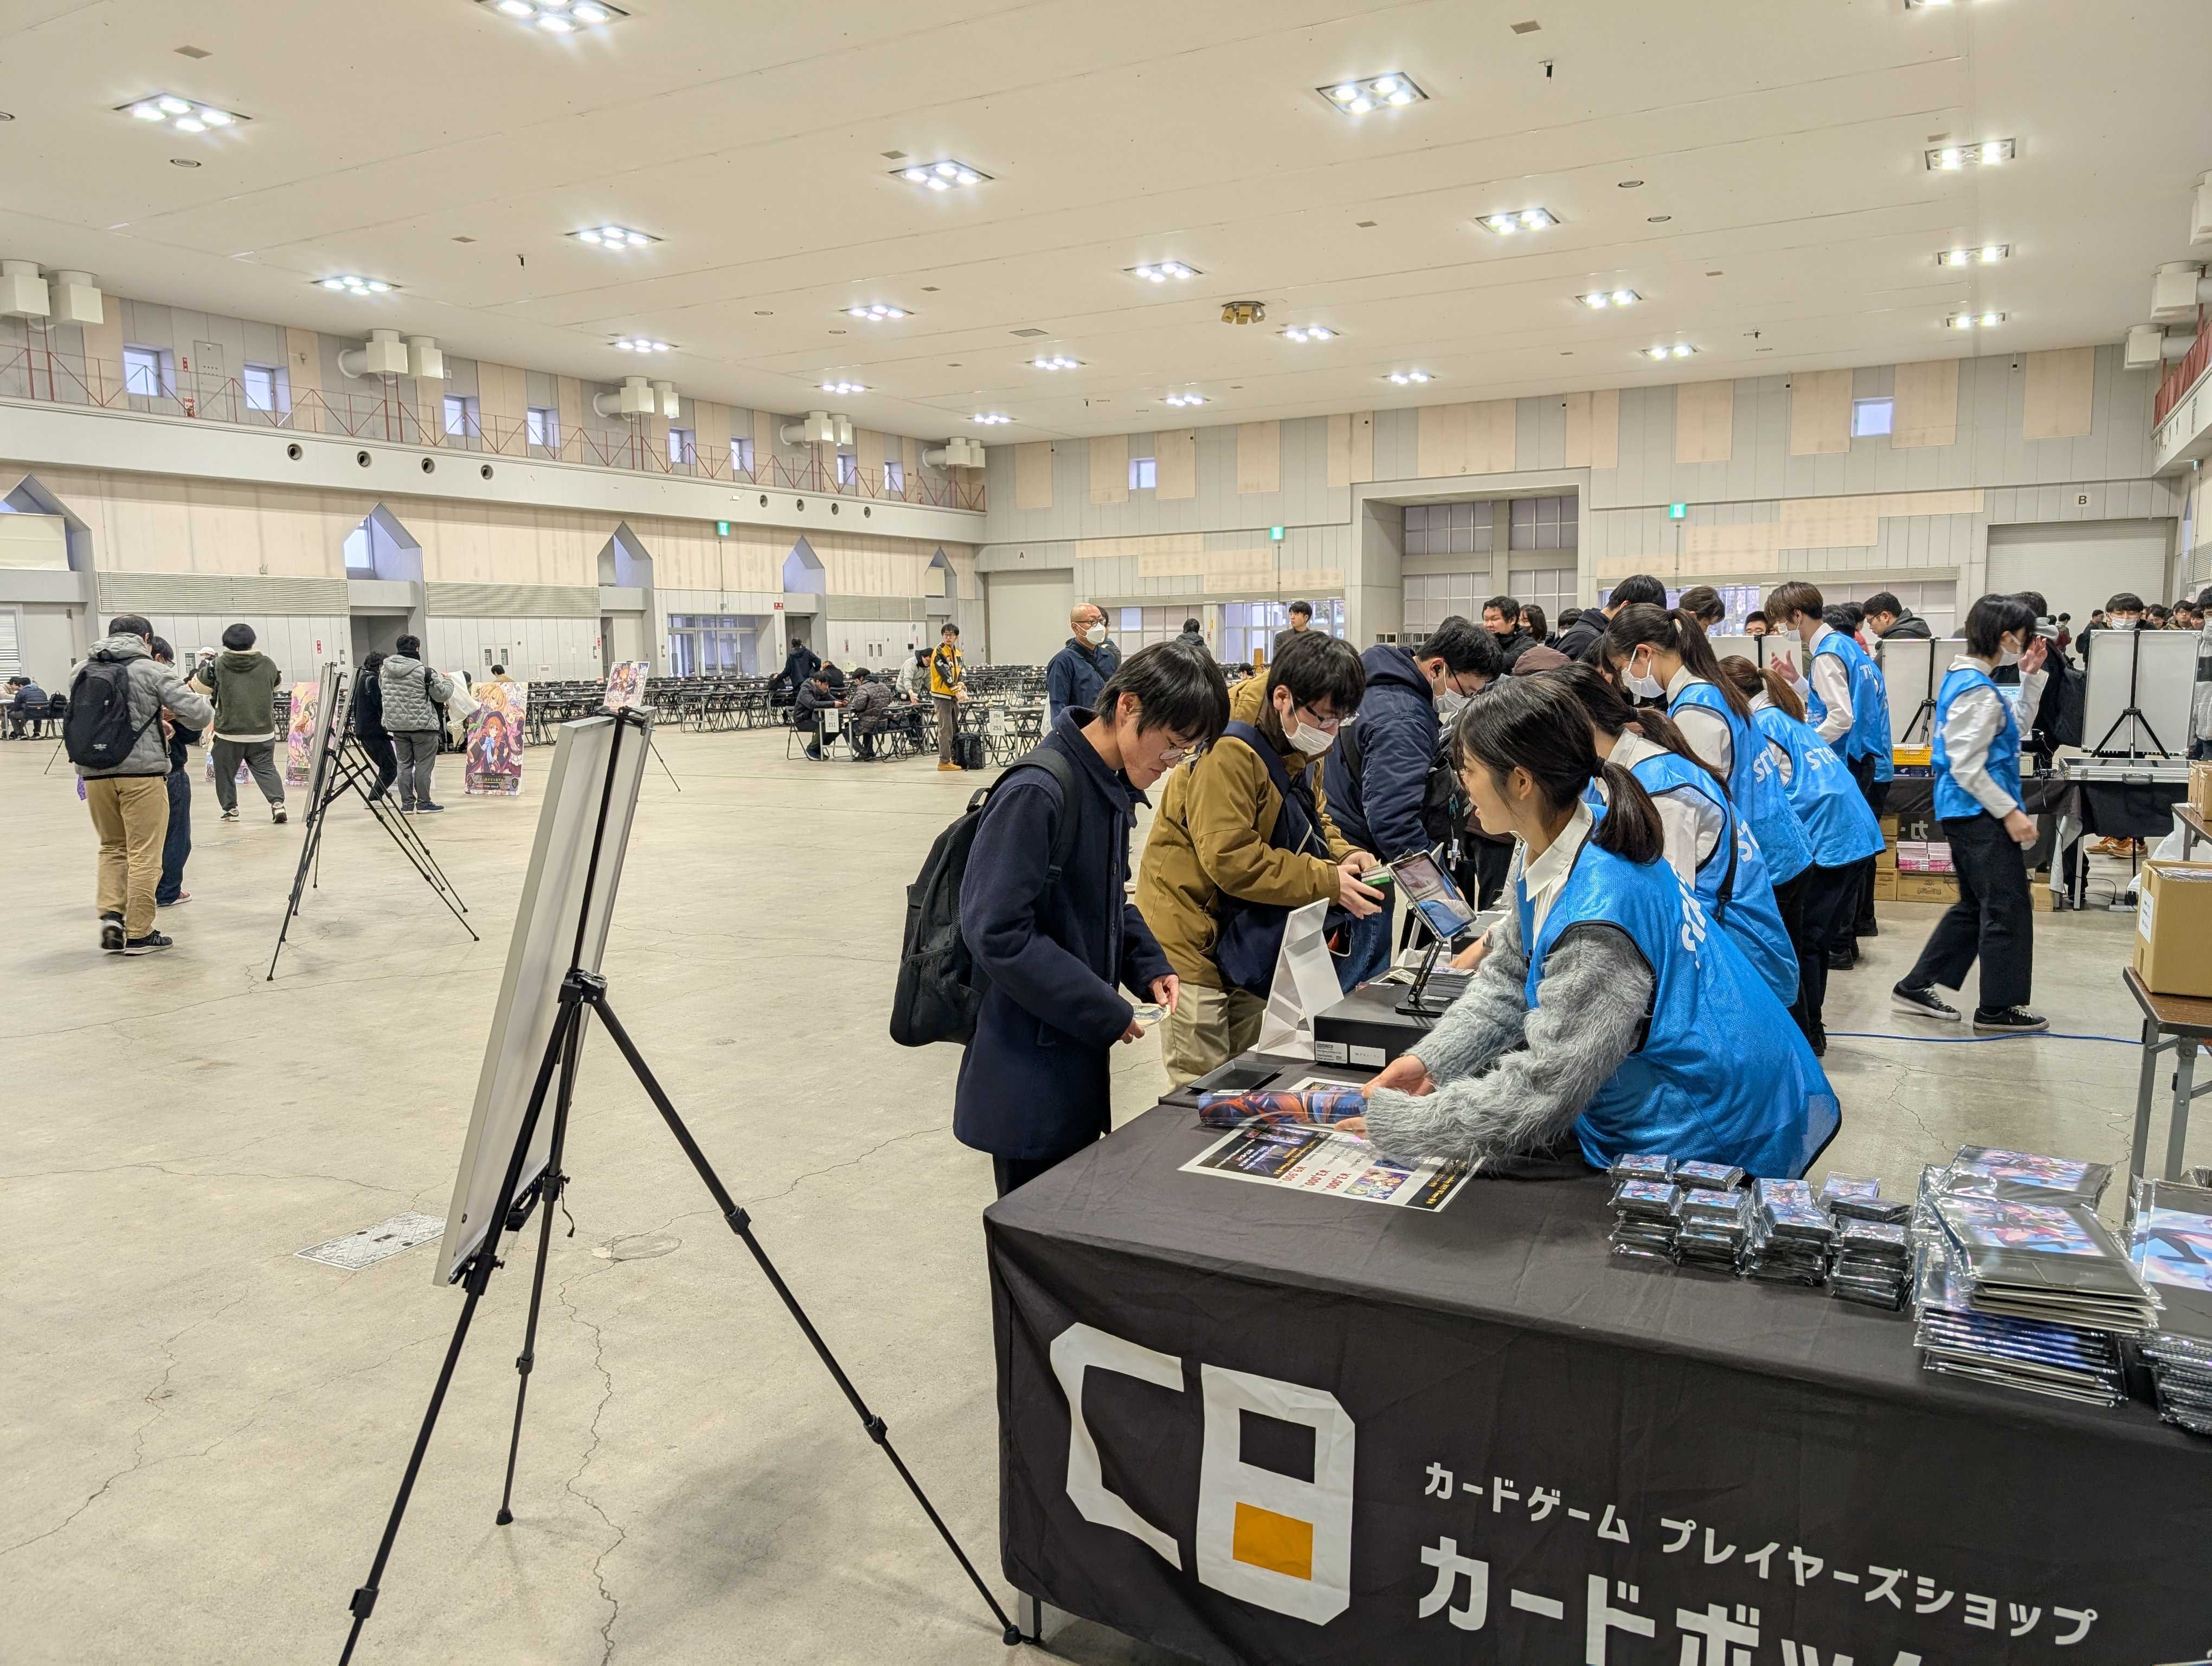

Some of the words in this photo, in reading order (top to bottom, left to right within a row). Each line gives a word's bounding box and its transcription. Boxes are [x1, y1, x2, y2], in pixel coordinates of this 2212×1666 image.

[2078, 495, 2087, 504] B
[1304, 1169, 1330, 1186] ¥3,000
[1326, 1172, 1352, 1189] ¥3,000
[1425, 1462, 1630, 1543] カードゲーム
[1661, 1518, 2098, 1645] プレイヤーズショップ
[1419, 1536, 1922, 1666] カードボ
